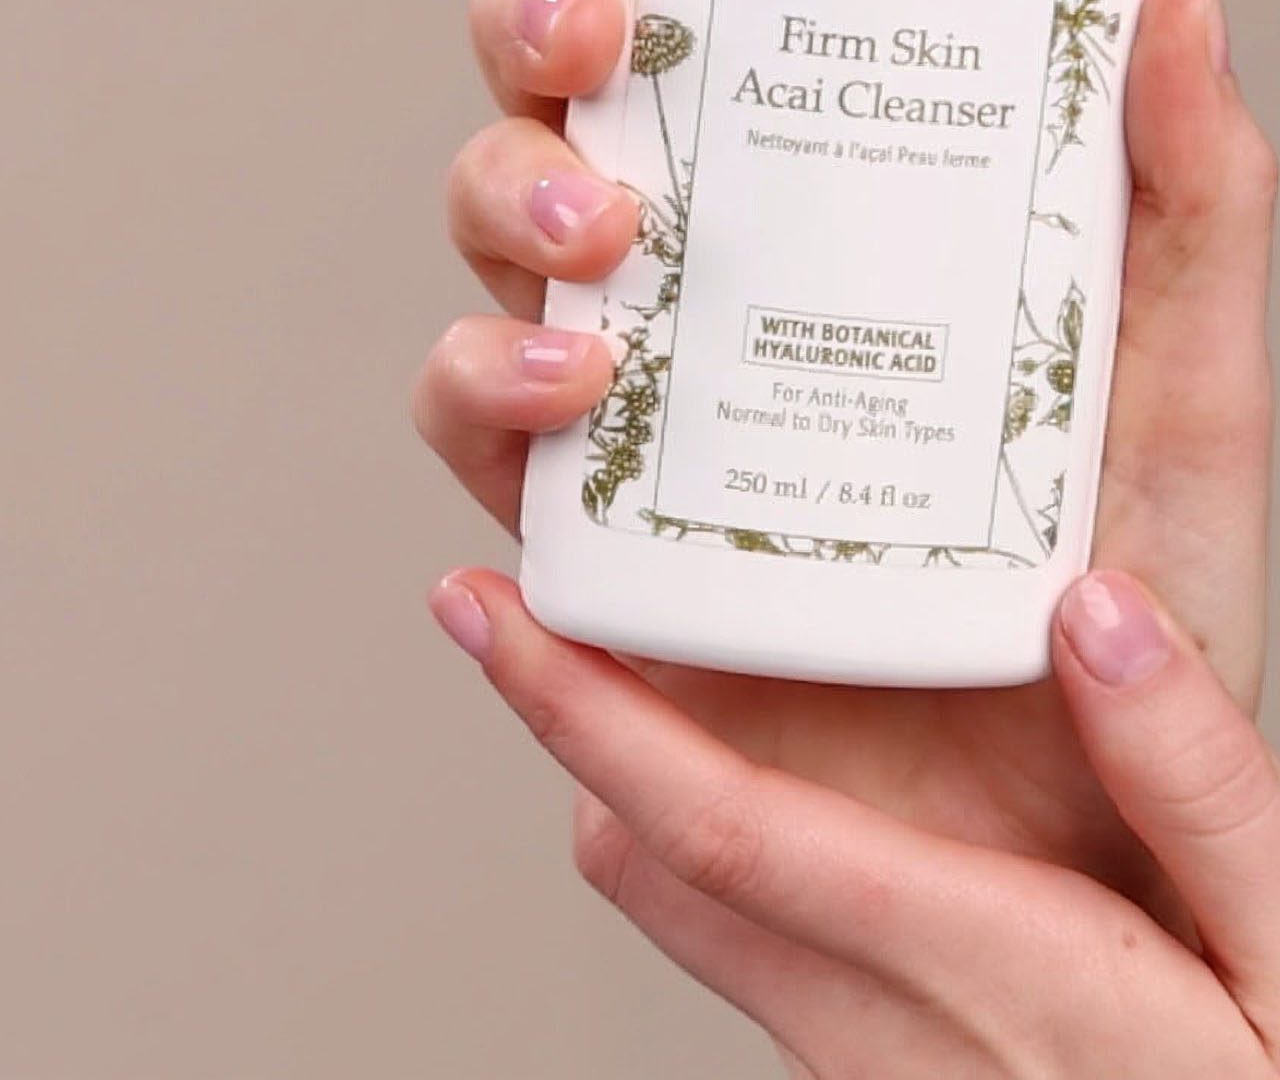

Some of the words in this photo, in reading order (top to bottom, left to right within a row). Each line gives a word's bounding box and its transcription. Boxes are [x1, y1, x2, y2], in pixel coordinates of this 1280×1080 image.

[780, 15, 877, 62] Firm
[891, 28, 982, 70] Skin
[731, 67, 823, 112] Acai
[838, 81, 1015, 128] Cleanser
[747, 129, 828, 156] Nettoyant
[834, 141, 843, 157] à
[899, 148, 937, 165] Peau
[943, 150, 991, 168] ferme
[761, 317, 814, 339] WITH
[822, 324, 935, 349] BOTANICAL
[754, 339, 883, 370] HYALURONIC
[890, 355, 936, 372] ACID
[773, 383, 804, 402] For
[808, 387, 908, 416] Anti-Aging
[717, 402, 786, 427] Normal
[793, 412, 811, 430] to
[819, 415, 852, 439] Dry
[856, 418, 896, 438] Skin
[905, 421, 954, 445] Types
[725, 469, 766, 494] 250
[774, 477, 806, 499] ml
[839, 484, 872, 505] 8.4
[881, 486, 895, 506] fl
[903, 492, 931, 508] oz
